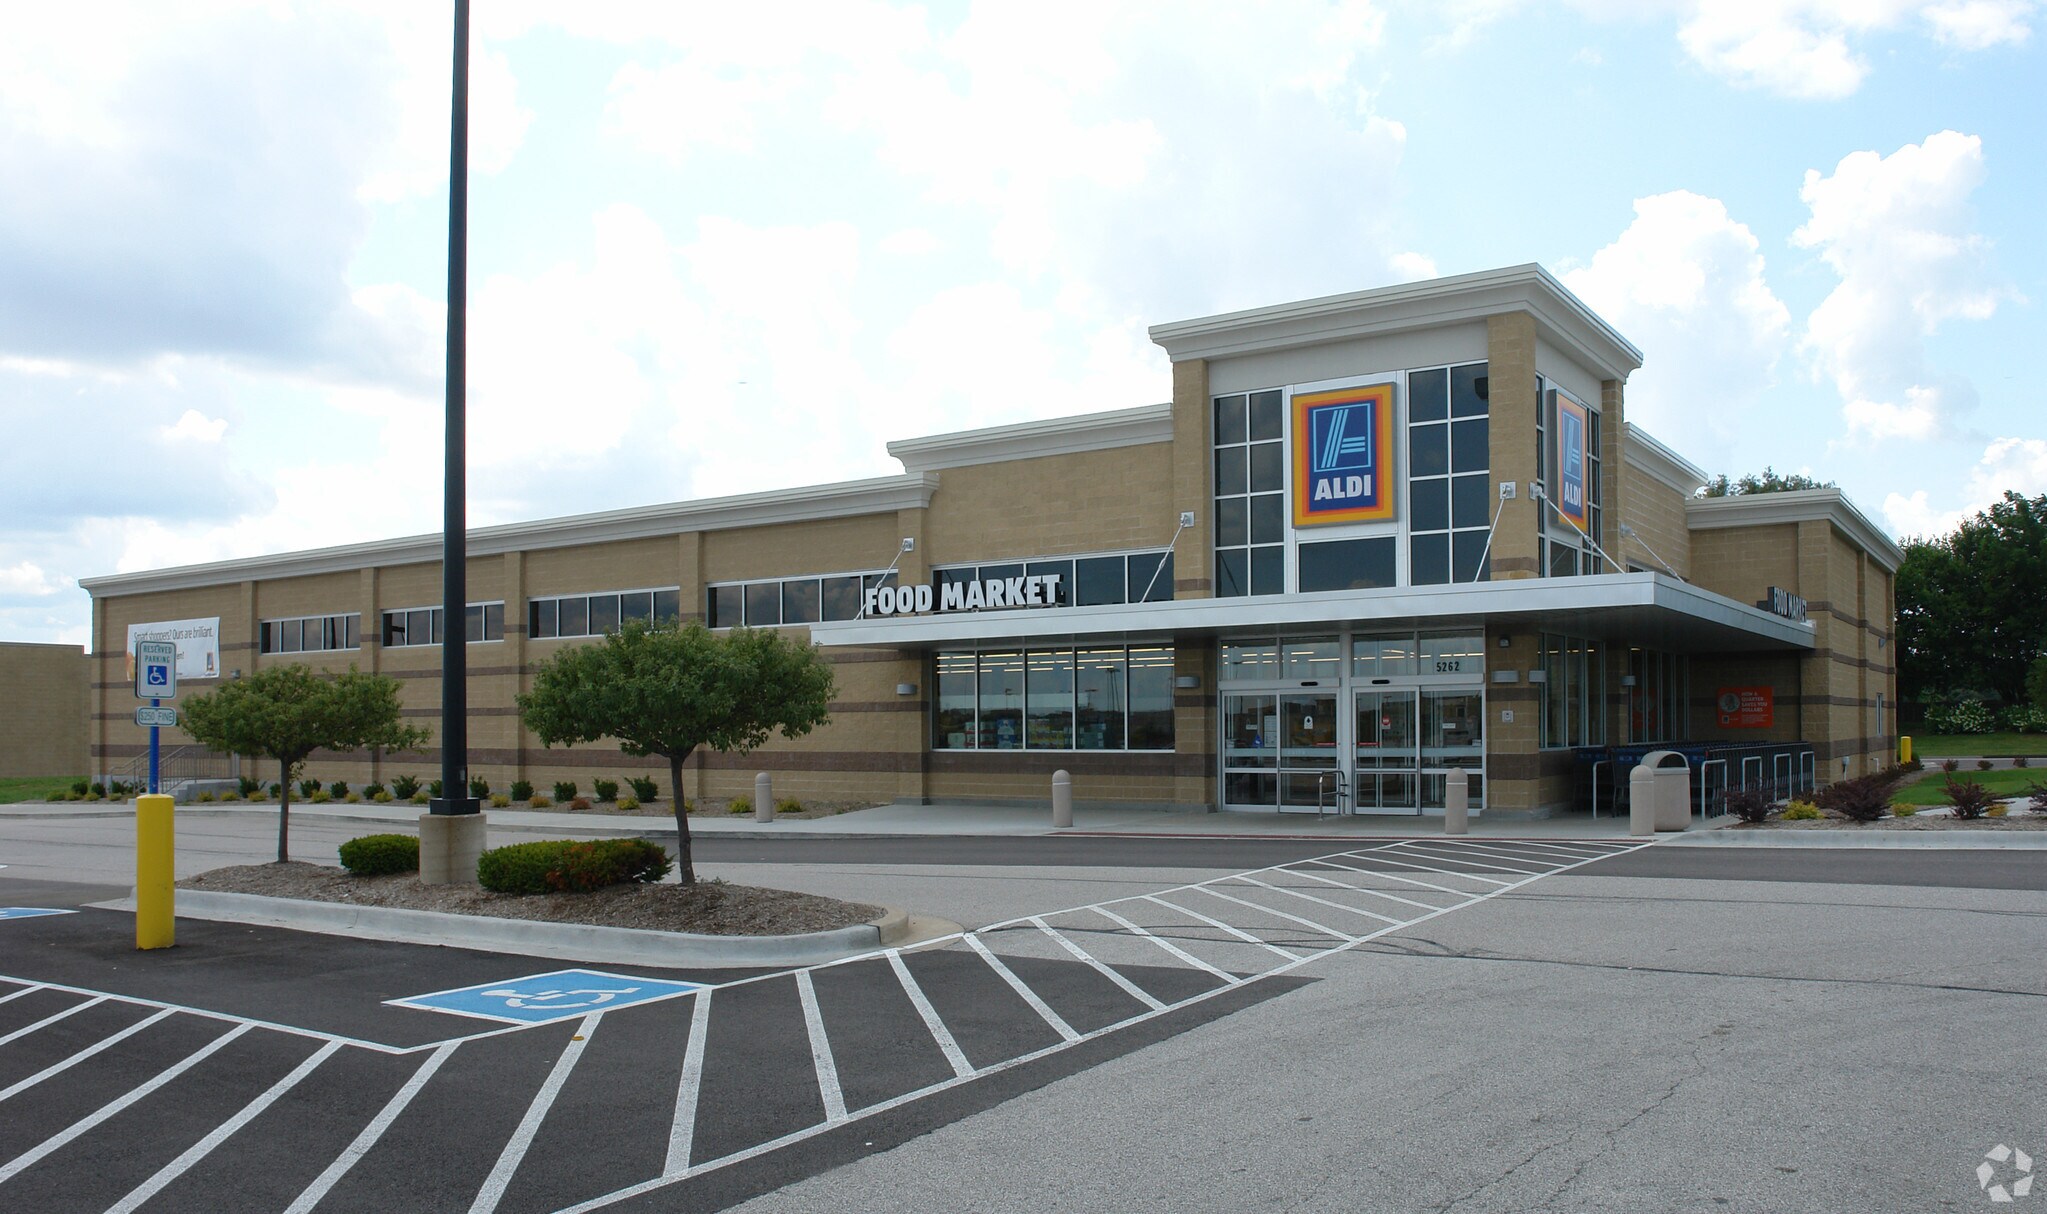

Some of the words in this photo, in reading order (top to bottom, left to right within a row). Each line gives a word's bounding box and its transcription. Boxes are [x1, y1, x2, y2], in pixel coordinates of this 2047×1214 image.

[1314, 474, 1371, 501] ALDI
[1564, 481, 1581, 507] ALDI
[865, 584, 933, 615] FOOD
[940, 574, 1061, 611] MARKET
[1773, 586, 1787, 616] FOOD
[1788, 592, 1807, 622] MARKET
[134, 631, 148, 641] Smart
[149, 629, 172, 641] shoppers?
[172, 629, 184, 640] Ours
[184, 630, 192, 639] are
[192, 625, 214, 639] brilliant.
[143, 645, 173, 654] RESERVED
[145, 655, 171, 664] PARKING
[1436, 661, 1460, 672] 5262
[140, 711, 155, 721] $250
[158, 712, 173, 721] FINE
